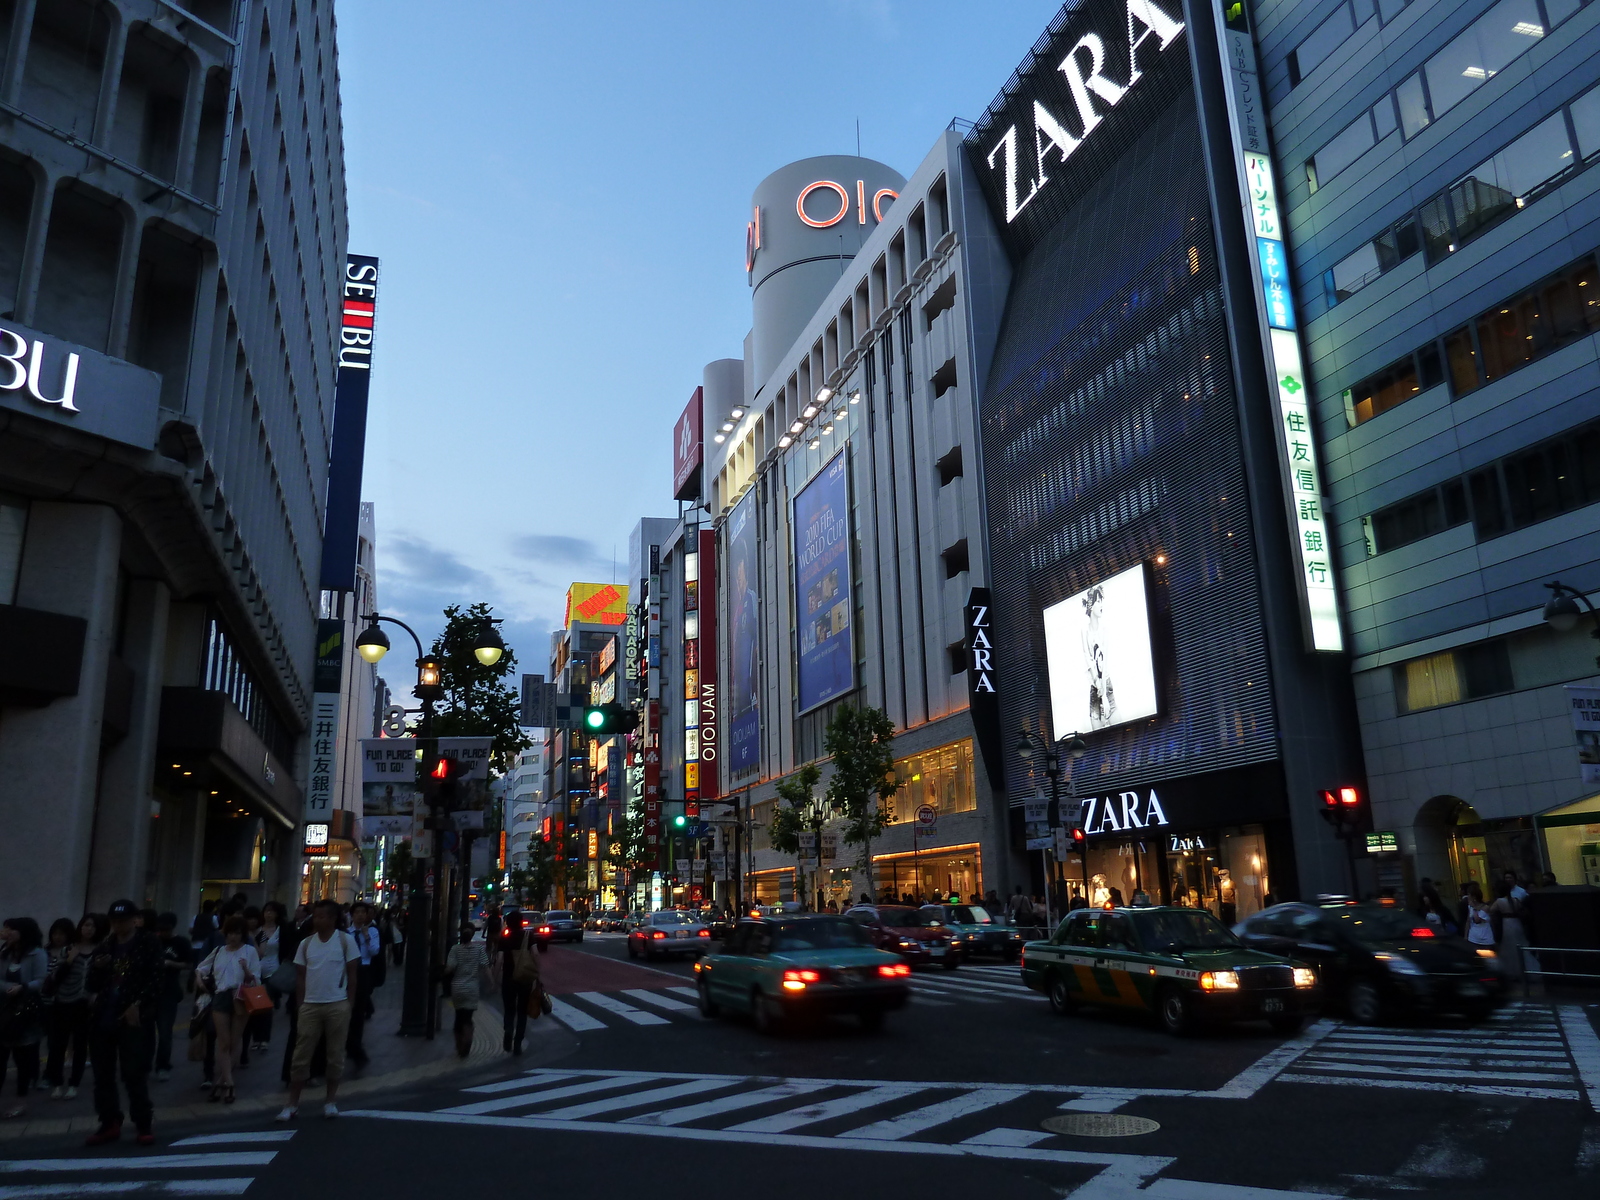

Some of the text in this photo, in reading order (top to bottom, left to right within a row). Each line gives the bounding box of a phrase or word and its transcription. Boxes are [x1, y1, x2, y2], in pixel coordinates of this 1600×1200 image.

[986, 0, 1186, 224] ZARA
[1251, 157, 1274, 234] パーソナル
[338, 262, 377, 370] SEIBU
[1286, 410, 1327, 584] 住友信託銀行
[798, 532, 827, 570] WORLD
[826, 518, 845, 546] CUP
[805, 519, 821, 547] 2010
[820, 507, 836, 535] FIFA
[575, 585, 621, 619] TOWER
[317, 659, 341, 667] SMBC
[626, 603, 638, 680] KARAOKE
[971, 605, 996, 693] ZARA
[703, 683, 716, 761] OIOIJAM
[310, 703, 334, 810] 三井住友銀行
[366, 749, 413, 760] FUN PLACE
[375, 762, 404, 772] TO GO!
[462, 748, 488, 759] PLACE
[1081, 788, 1169, 835] ZARA
[304, 845, 327, 853] alook
